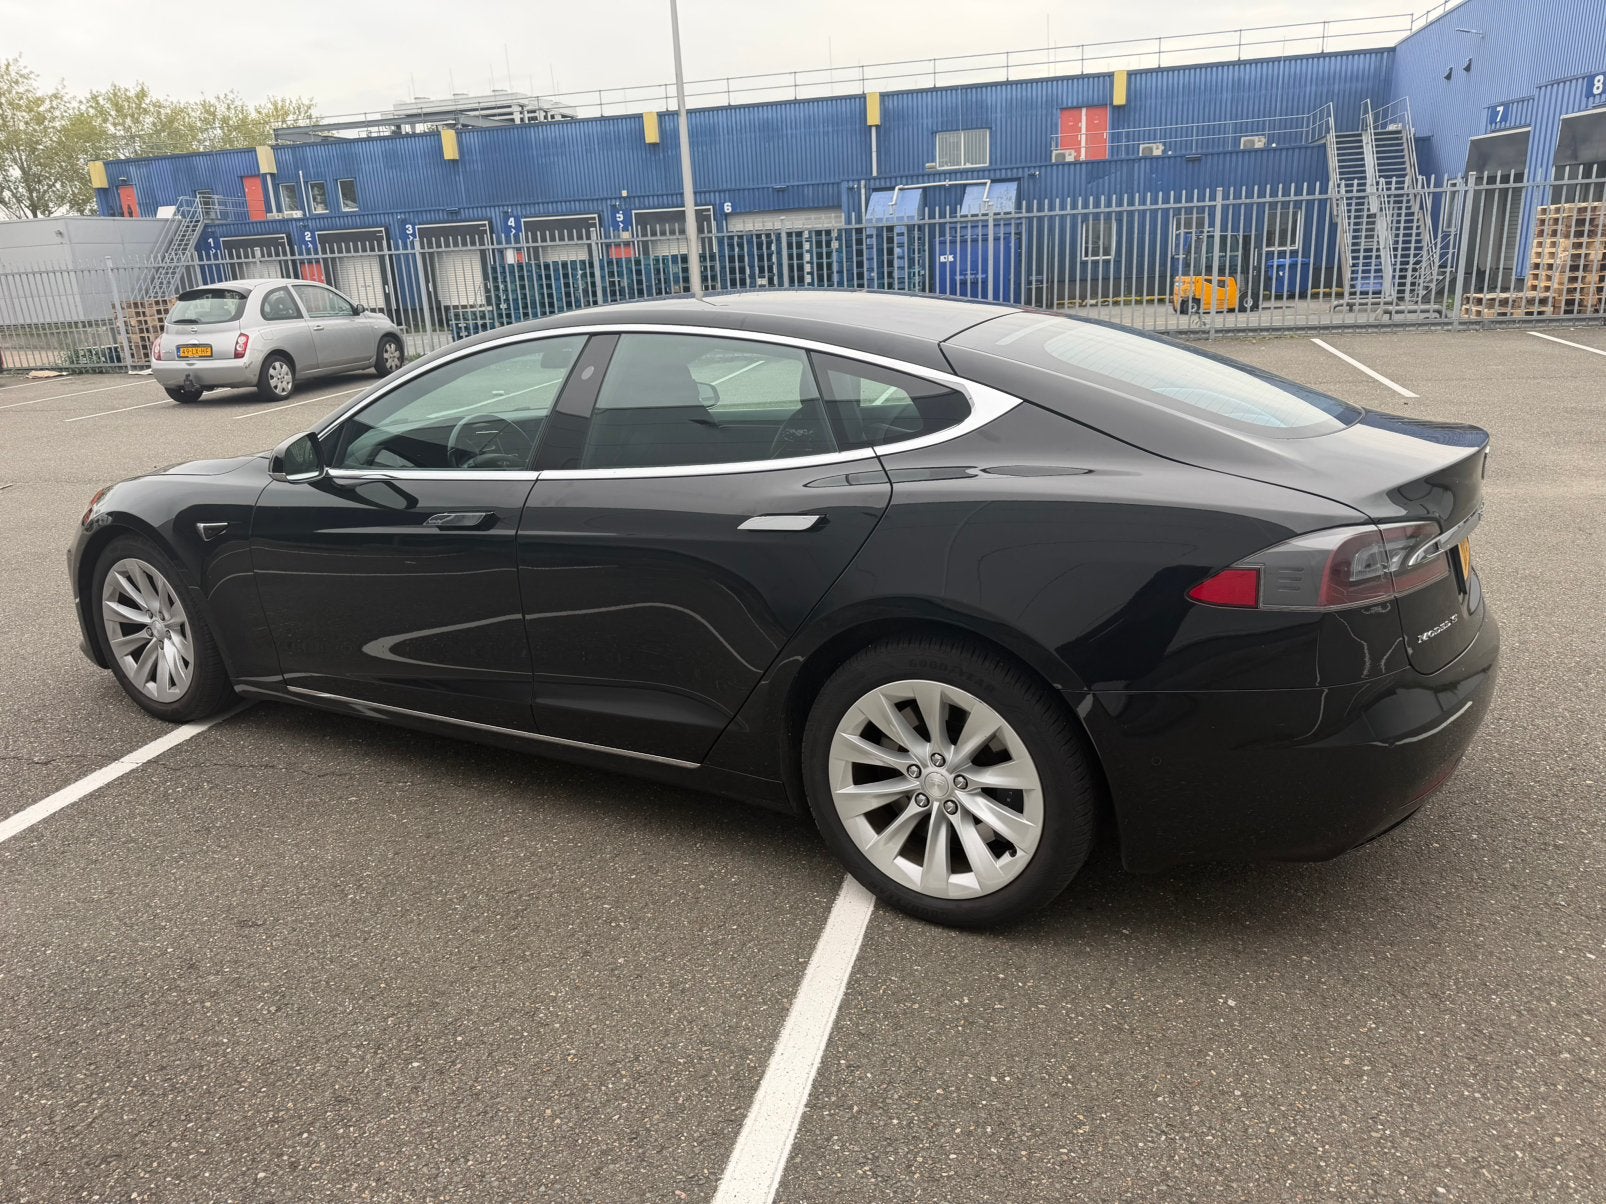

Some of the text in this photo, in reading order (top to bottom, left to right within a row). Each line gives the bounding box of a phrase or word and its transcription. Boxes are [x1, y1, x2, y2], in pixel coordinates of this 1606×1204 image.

[1593, 74, 1604, 95] 8
[1496, 105, 1504, 122] 7
[724, 202, 732, 213] 6
[616, 210, 624, 222] 5
[508, 217, 515, 227] 4
[405, 224, 413, 234] 3
[304, 231, 312, 241] 2
[207, 237, 214, 247] 1
